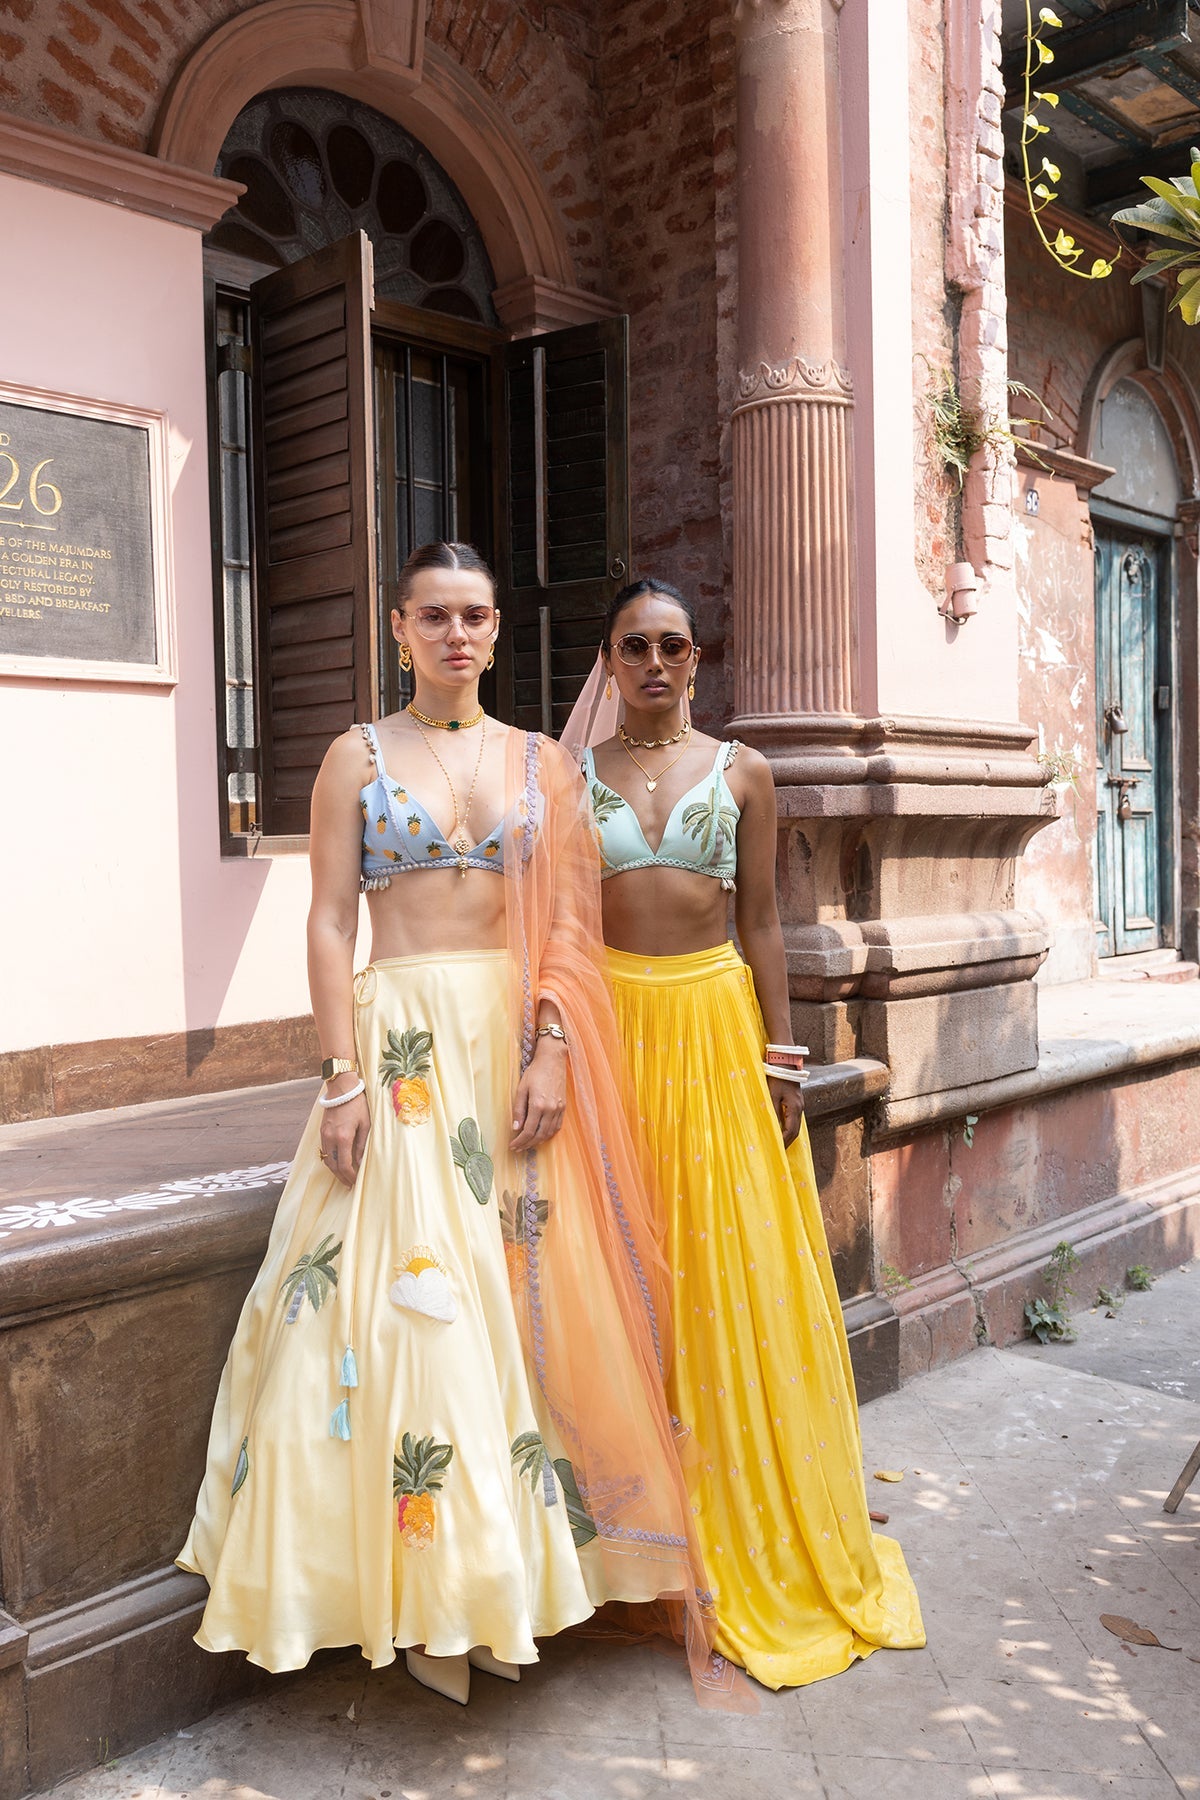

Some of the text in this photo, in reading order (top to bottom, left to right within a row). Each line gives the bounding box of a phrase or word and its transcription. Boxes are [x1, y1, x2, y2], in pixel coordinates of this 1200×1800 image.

[0, 451, 62, 515] 26
[8, 537, 22, 548] OF
[25, 540, 46, 551] THE
[49, 543, 112, 559] MAJUMDARS
[1, 551, 93, 571] A GOLDEN ERA IN
[53, 570, 95, 585] LEGACY.
[0, 579, 92, 597] GLY RESTORED BY
[28, 596, 53, 607] AND
[55, 598, 111, 613] BREAKFAST
